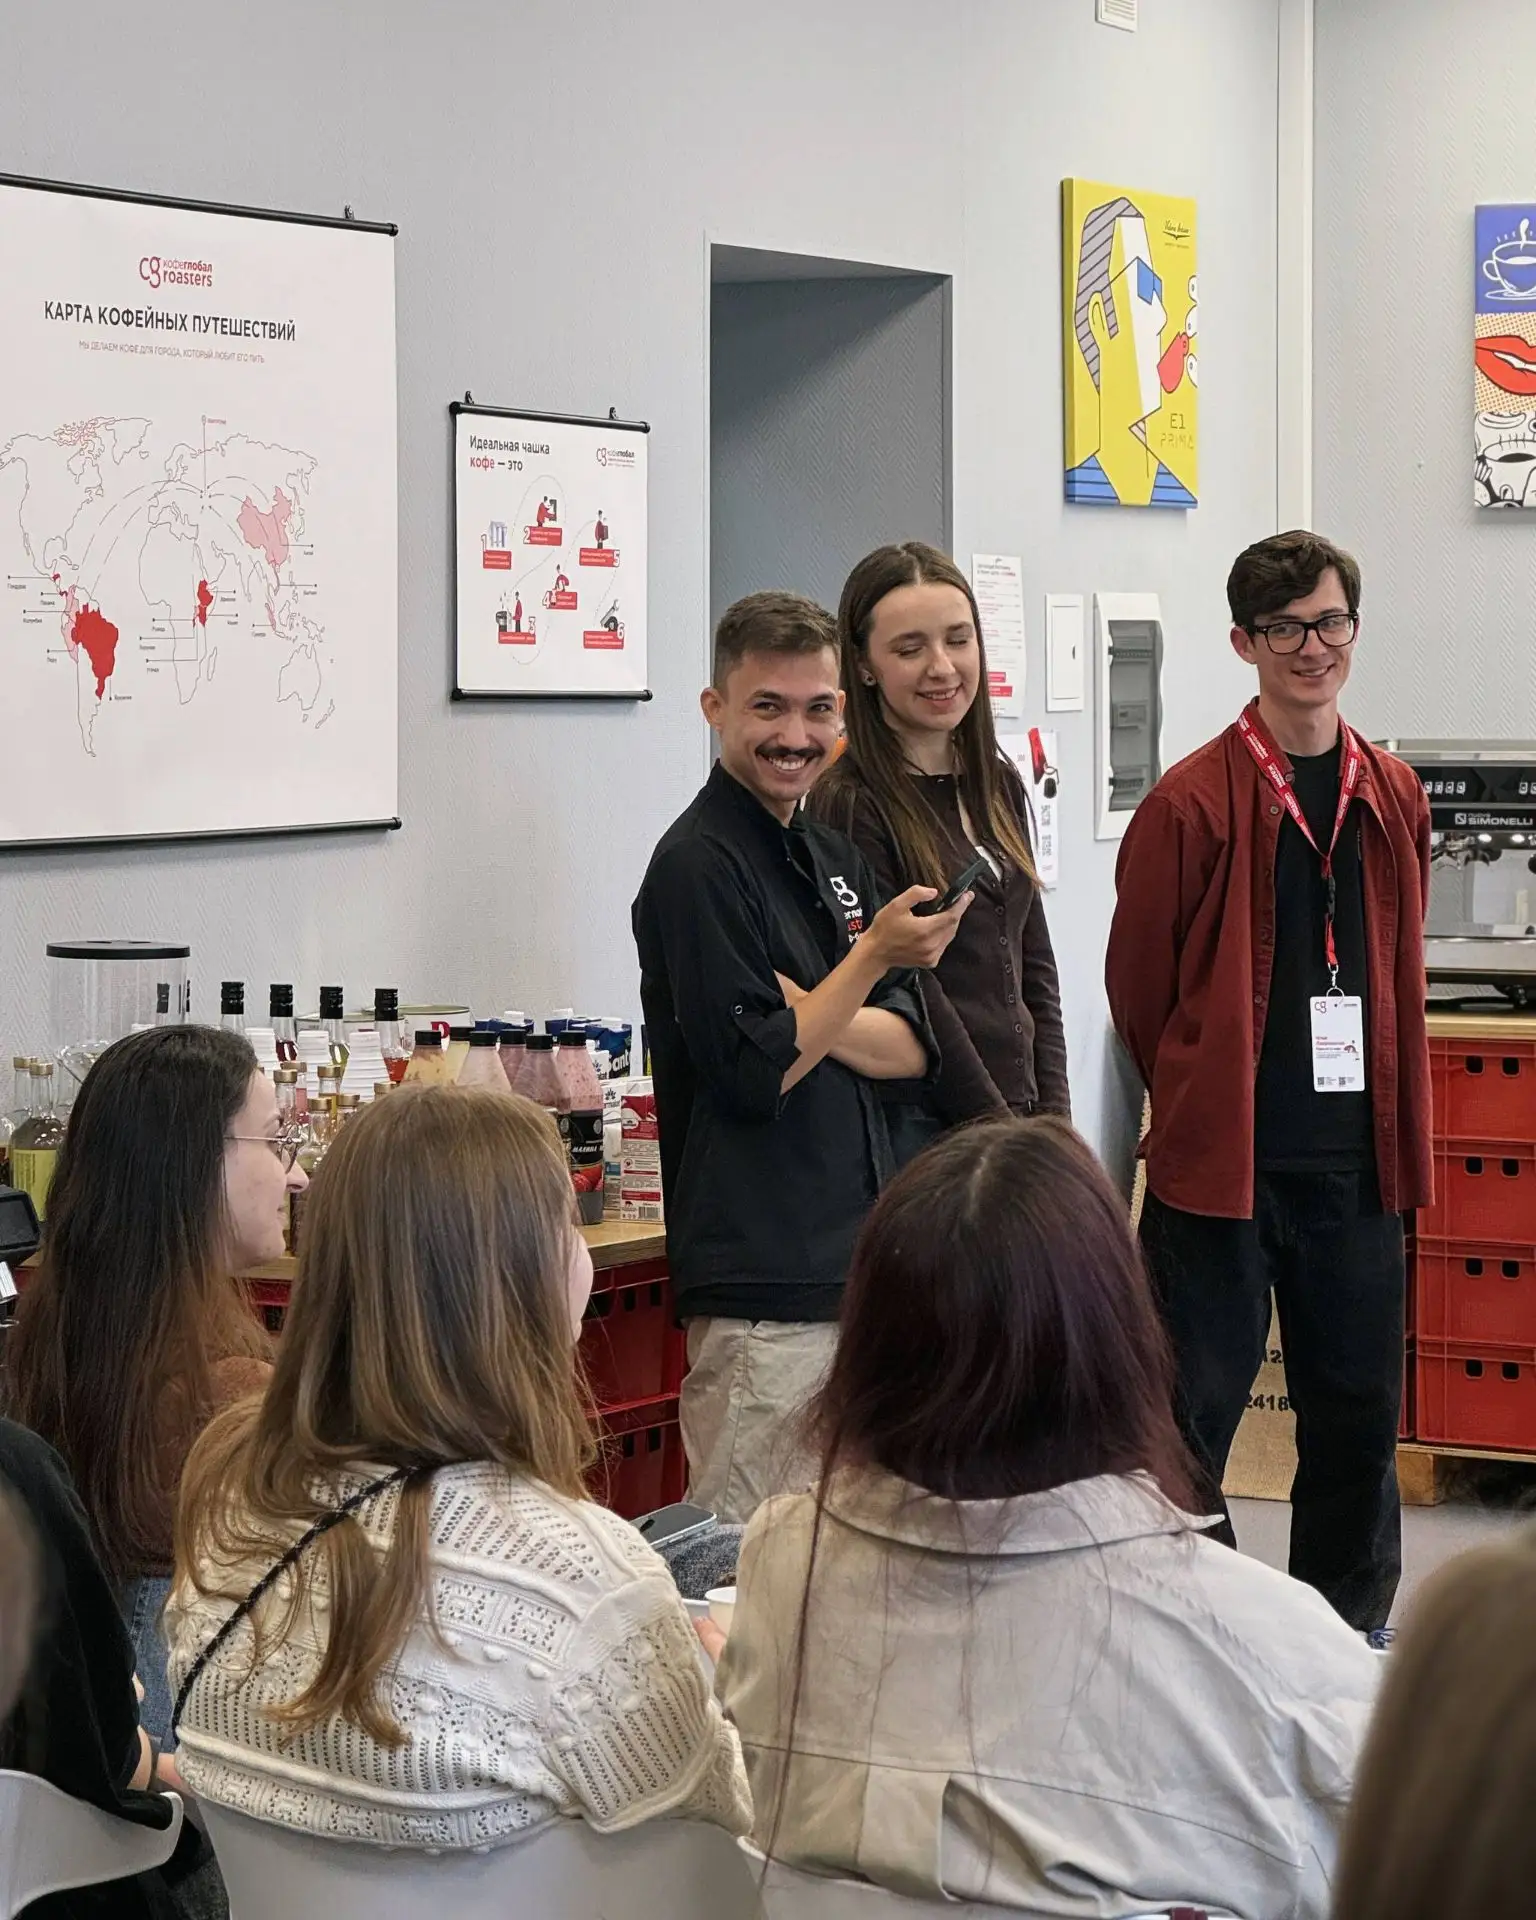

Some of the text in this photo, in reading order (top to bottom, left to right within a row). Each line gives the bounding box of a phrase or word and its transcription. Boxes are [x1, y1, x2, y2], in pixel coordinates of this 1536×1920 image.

[163, 259, 213, 273] кофеглобал
[163, 270, 213, 287] roasters
[44, 300, 296, 341] КАРТА КОФЕЙНЫХ ПУТЕШЕСТВИЙ
[469, 435, 550, 455] Идеальная чашка
[1160, 433, 1195, 451] PRIMA
[469, 456, 495, 471] кофе
[507, 460, 523, 471] это
[1467, 817, 1534, 826] SIMONELLI
